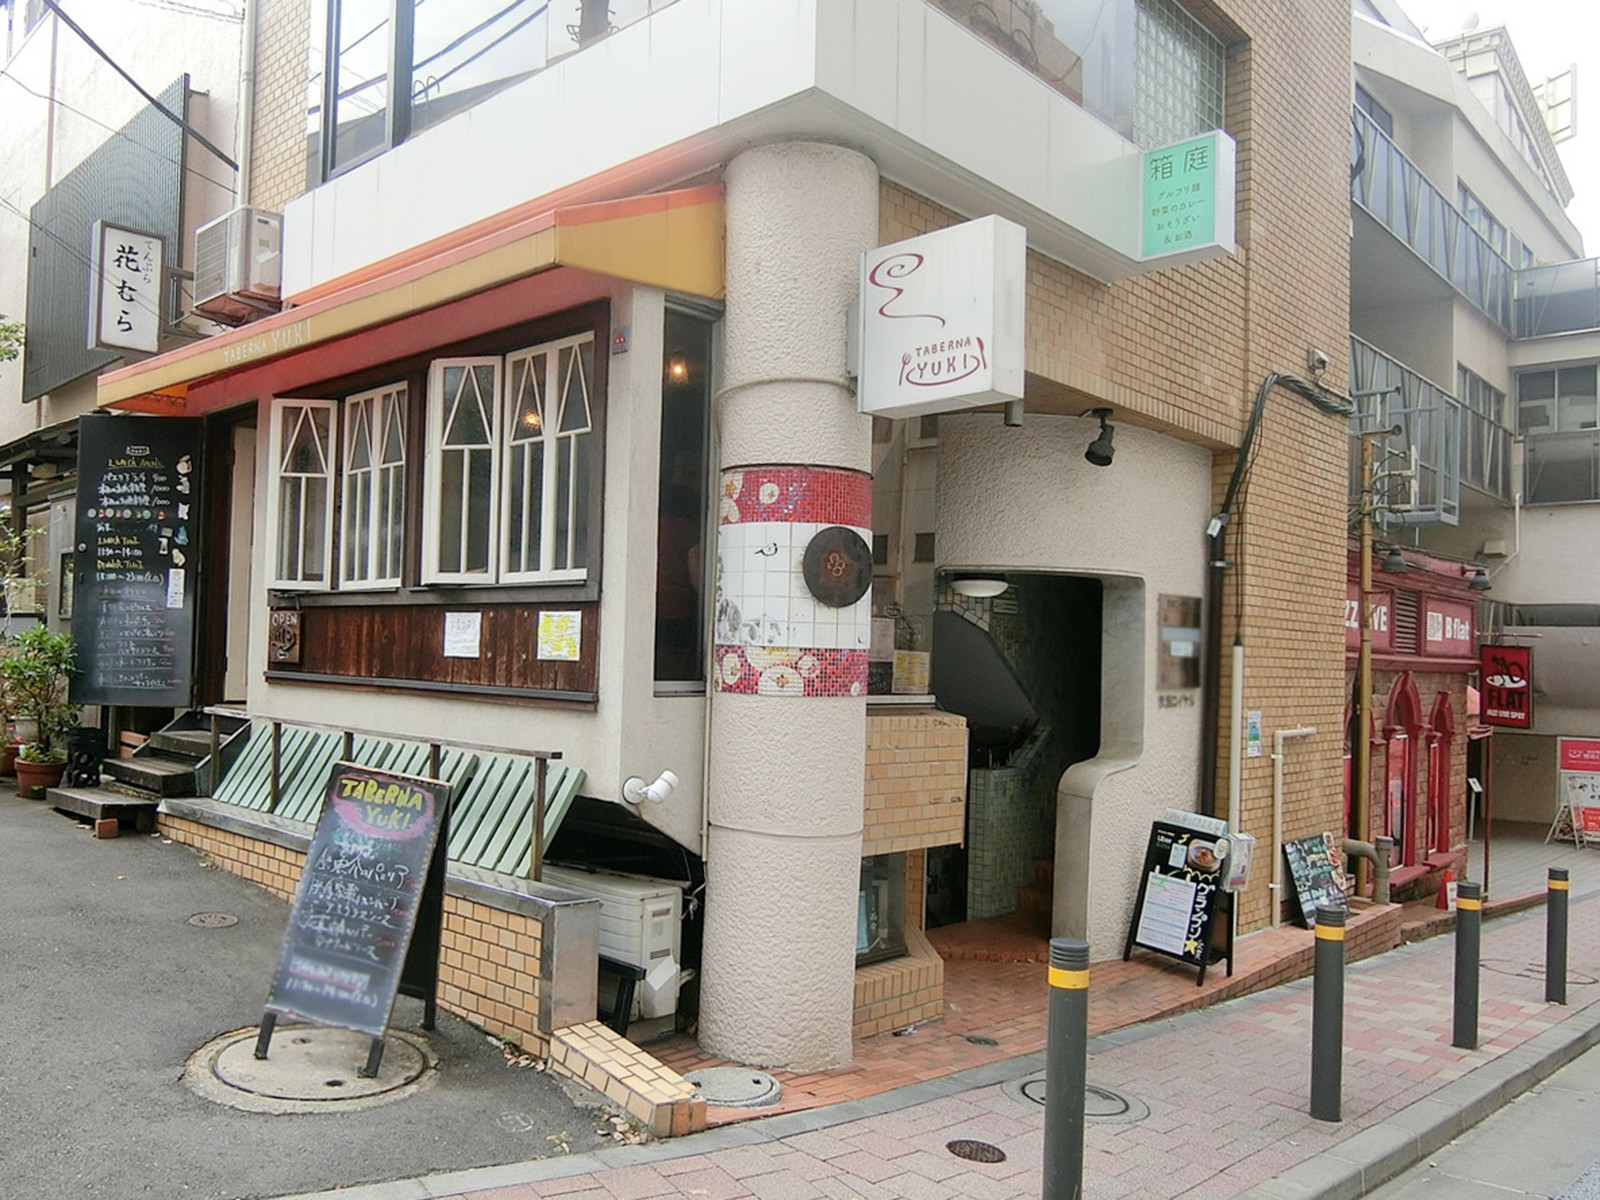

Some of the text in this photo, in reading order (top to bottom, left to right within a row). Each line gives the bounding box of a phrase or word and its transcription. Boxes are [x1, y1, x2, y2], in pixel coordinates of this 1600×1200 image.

[1150, 146, 1208, 181] 箱庭
[1152, 199, 1206, 217] 野菜のカレー
[1157, 215, 1201, 231] おそうざい
[143, 240, 154, 284] てんぷら
[113, 244, 142, 332] 花むら
[223, 318, 312, 362] TABERNA YUKI
[915, 337, 971, 357] TABERNA
[917, 353, 967, 379] YUKI
[272, 612, 298, 627] OPEN
[1344, 600, 1359, 627] ZZ
[1488, 688, 1526, 709] FLAT
